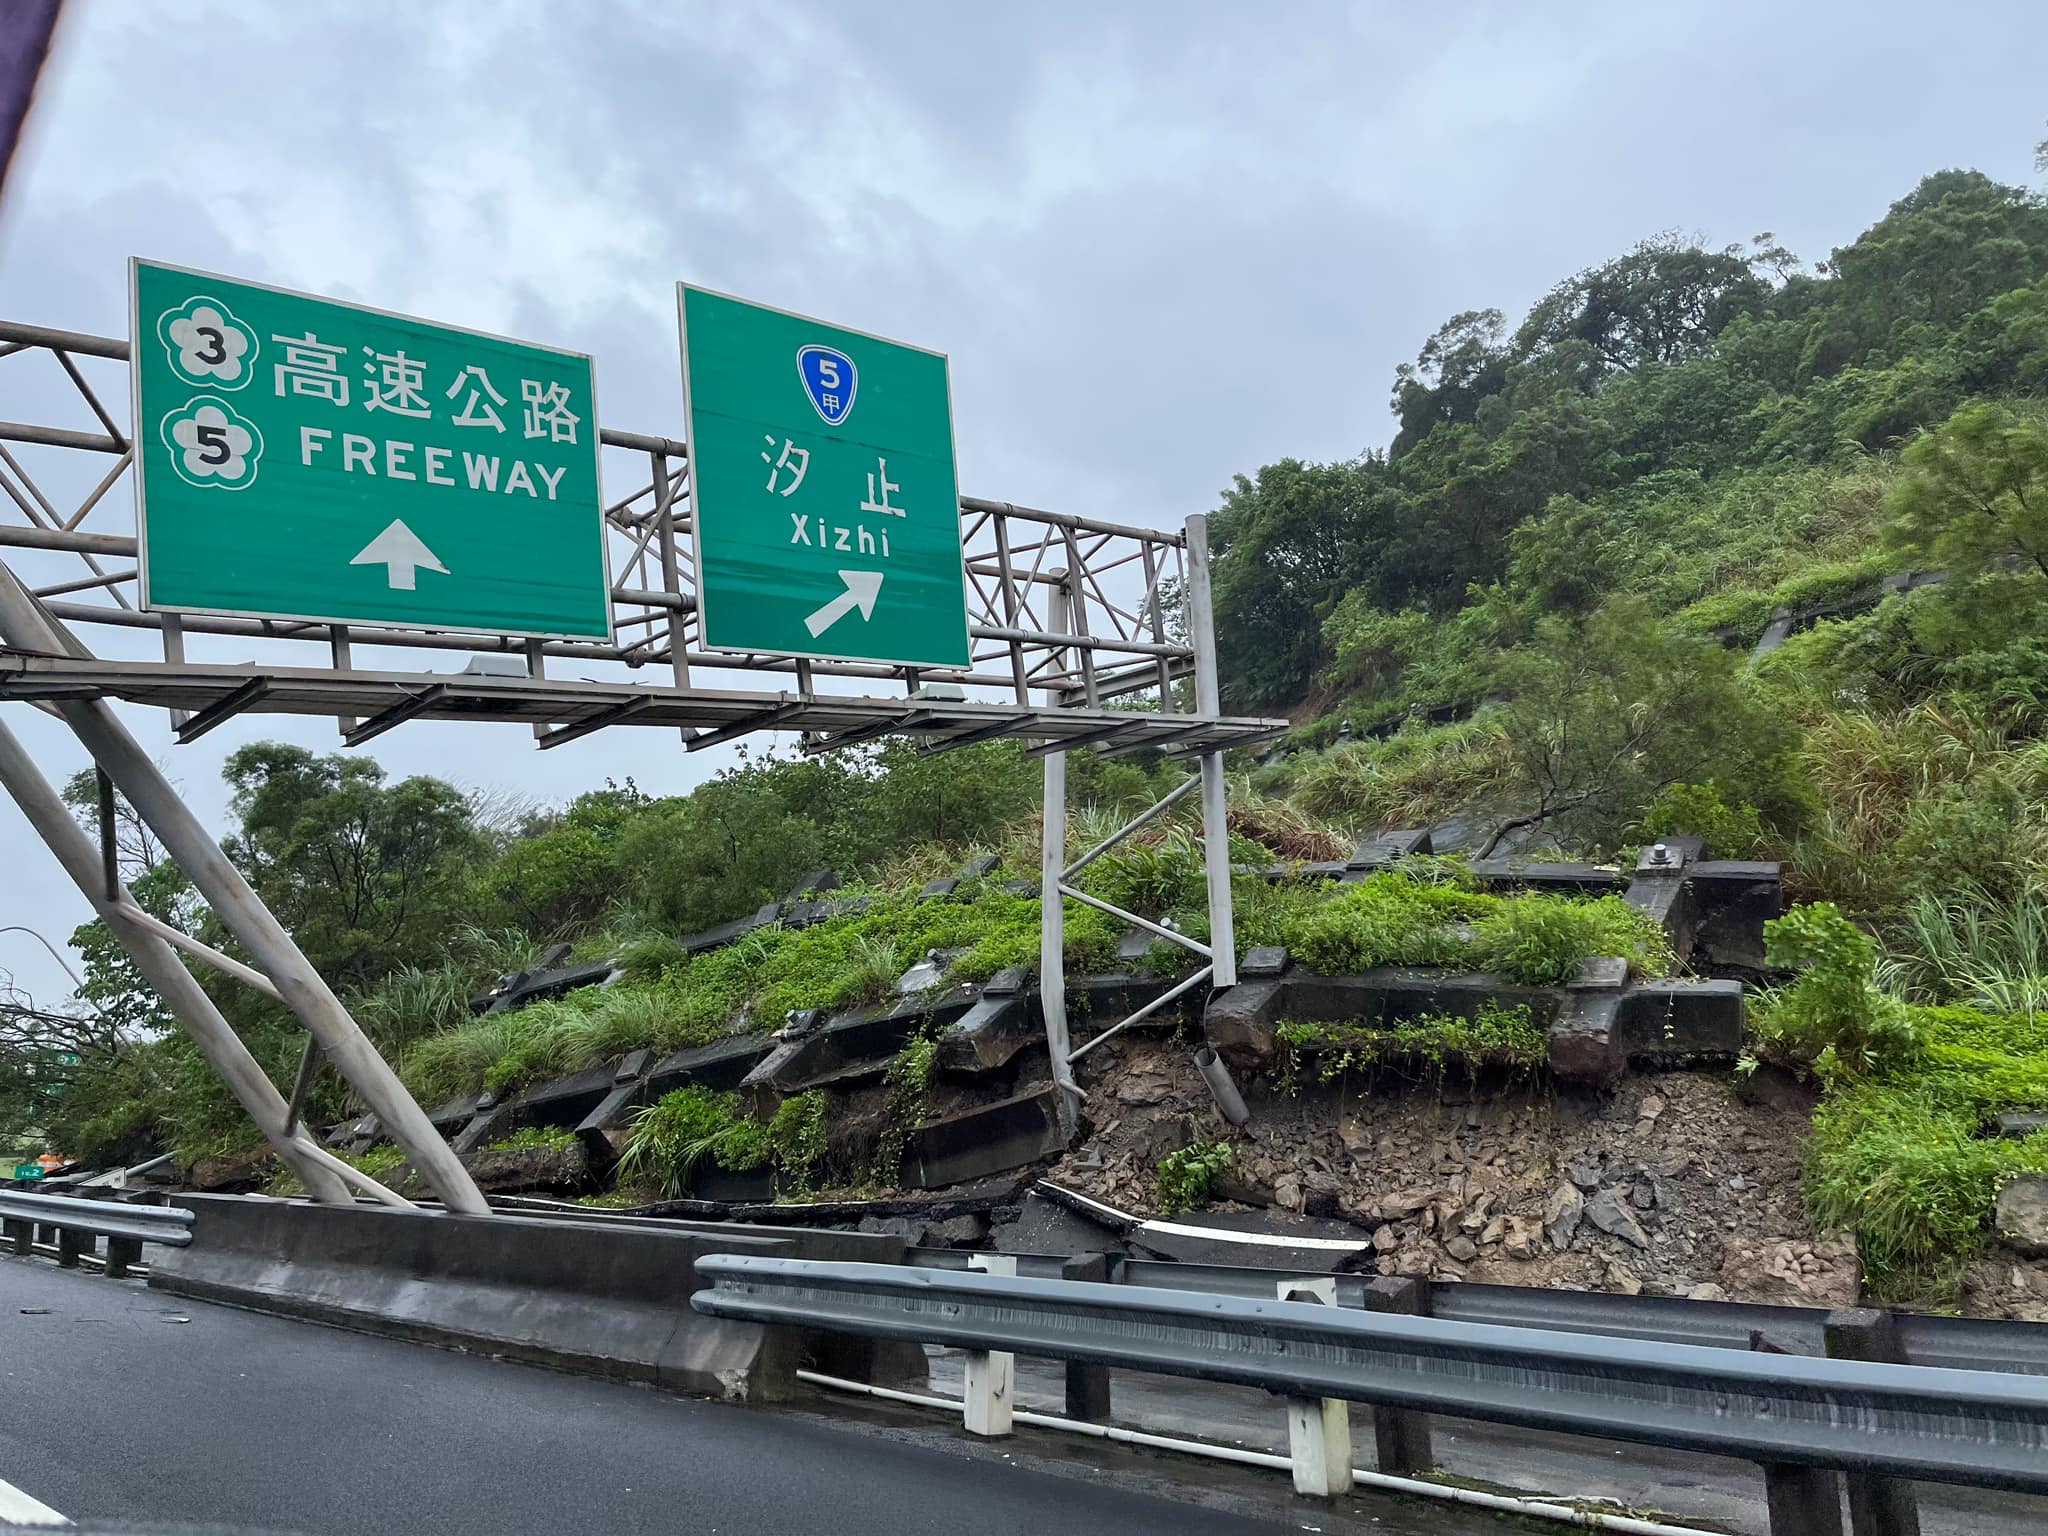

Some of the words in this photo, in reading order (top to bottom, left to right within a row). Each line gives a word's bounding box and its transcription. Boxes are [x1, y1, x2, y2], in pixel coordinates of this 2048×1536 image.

[195, 327, 227, 365] 3
[271, 332, 580, 445] 高速公路
[819, 359, 840, 389] 5
[822, 393, 840, 414] 甲
[197, 425, 231, 465] 5
[300, 426, 567, 500] FREEWAY
[760, 434, 906, 517] 汐止
[790, 513, 889, 557] Xizhi
